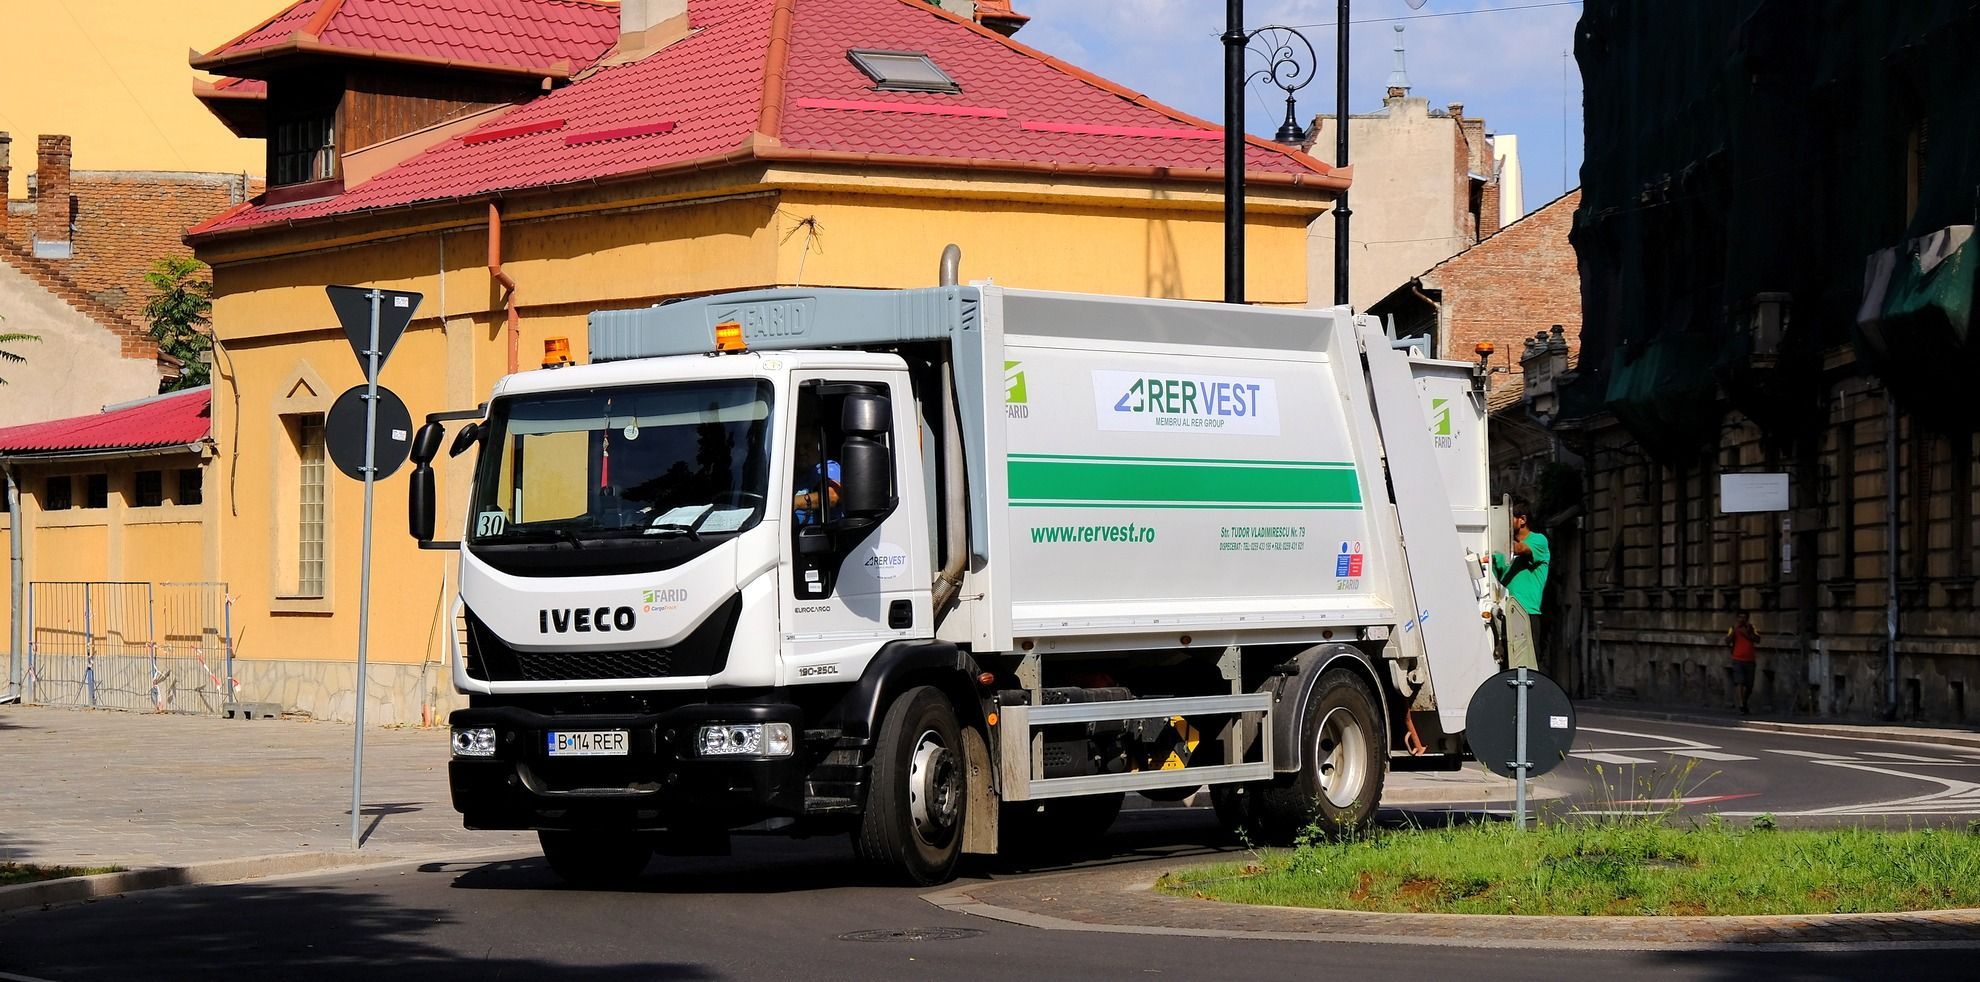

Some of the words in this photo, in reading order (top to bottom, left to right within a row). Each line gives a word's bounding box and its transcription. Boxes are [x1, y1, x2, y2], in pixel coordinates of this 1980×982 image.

[745, 303, 805, 338] FARID
[1156, 417, 1182, 427] MEMBRU
[1182, 418, 1191, 427] AL
[1191, 419, 1203, 427] RER
[1204, 419, 1225, 428] GROUP
[1434, 436, 1452, 449] FARID
[480, 515, 502, 536] 30
[1031, 522, 1155, 543] www.rervest.ro
[1231, 527, 1250, 538] TUDOR
[1342, 579, 1360, 590] FARID
[654, 588, 688, 602] FARID
[794, 605, 831, 614] EUROCARGO
[539, 605, 637, 634] IVECO
[799, 665, 839, 677] 190-250L
[558, 733, 568, 750] B
[572, 733, 590, 750] 114
[593, 733, 623, 750] RER
